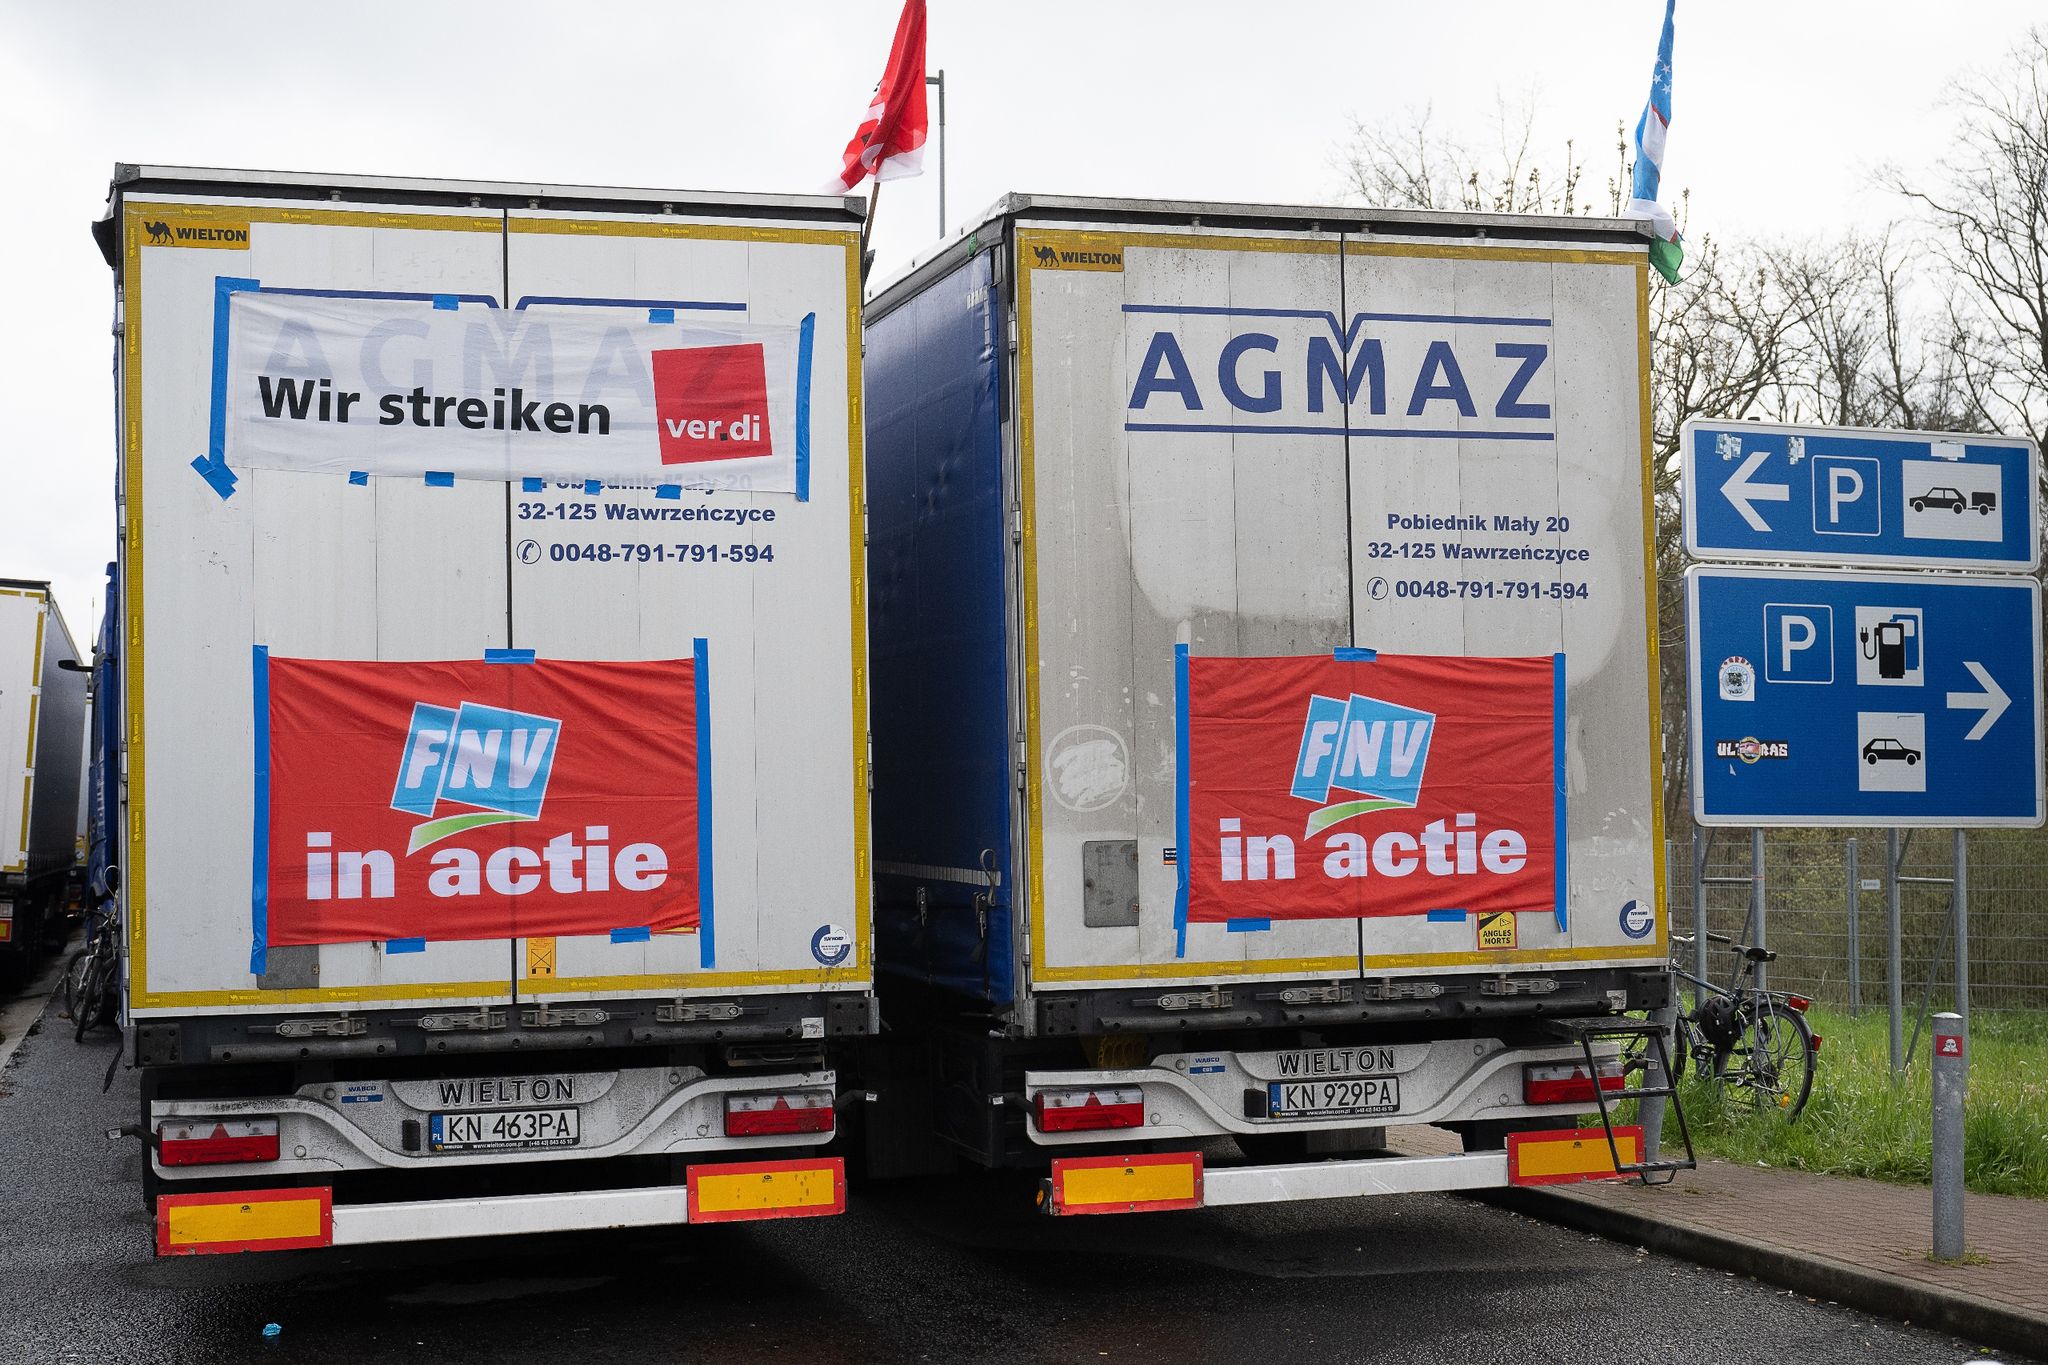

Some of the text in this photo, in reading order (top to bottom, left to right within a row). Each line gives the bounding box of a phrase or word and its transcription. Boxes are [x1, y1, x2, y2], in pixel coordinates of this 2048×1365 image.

[176, 226, 247, 242] WIELTON
[1061, 251, 1122, 265] WIELTON
[1128, 331, 1551, 418] AGMAZ
[258, 376, 610, 435] Wir streiken
[665, 414, 760, 442] ver.di
[1829, 467, 1864, 523] P
[518, 502, 776, 526] 32-125 Wawrzeńczyce
[1387, 513, 1570, 536] Pobiednik Mały 20
[550, 543, 774, 563] 0048-791-791-594
[1367, 542, 1590, 566] 32-125 Wawrzeńczyce
[1395, 580, 1589, 602] 0048-791-791-594
[1781, 615, 1816, 672] P
[405, 728, 549, 789] FNV
[1302, 720, 1427, 779] FNV
[1220, 812, 1528, 882] in actie
[307, 825, 669, 900] in actie
[1482, 930, 1512, 938] ANGLES
[1277, 1049, 1395, 1077] WIELTON
[438, 1076, 575, 1106] WIELTON
[1286, 1080, 1392, 1109] KN 929PA
[449, 1112, 571, 1142] KN 463PA
